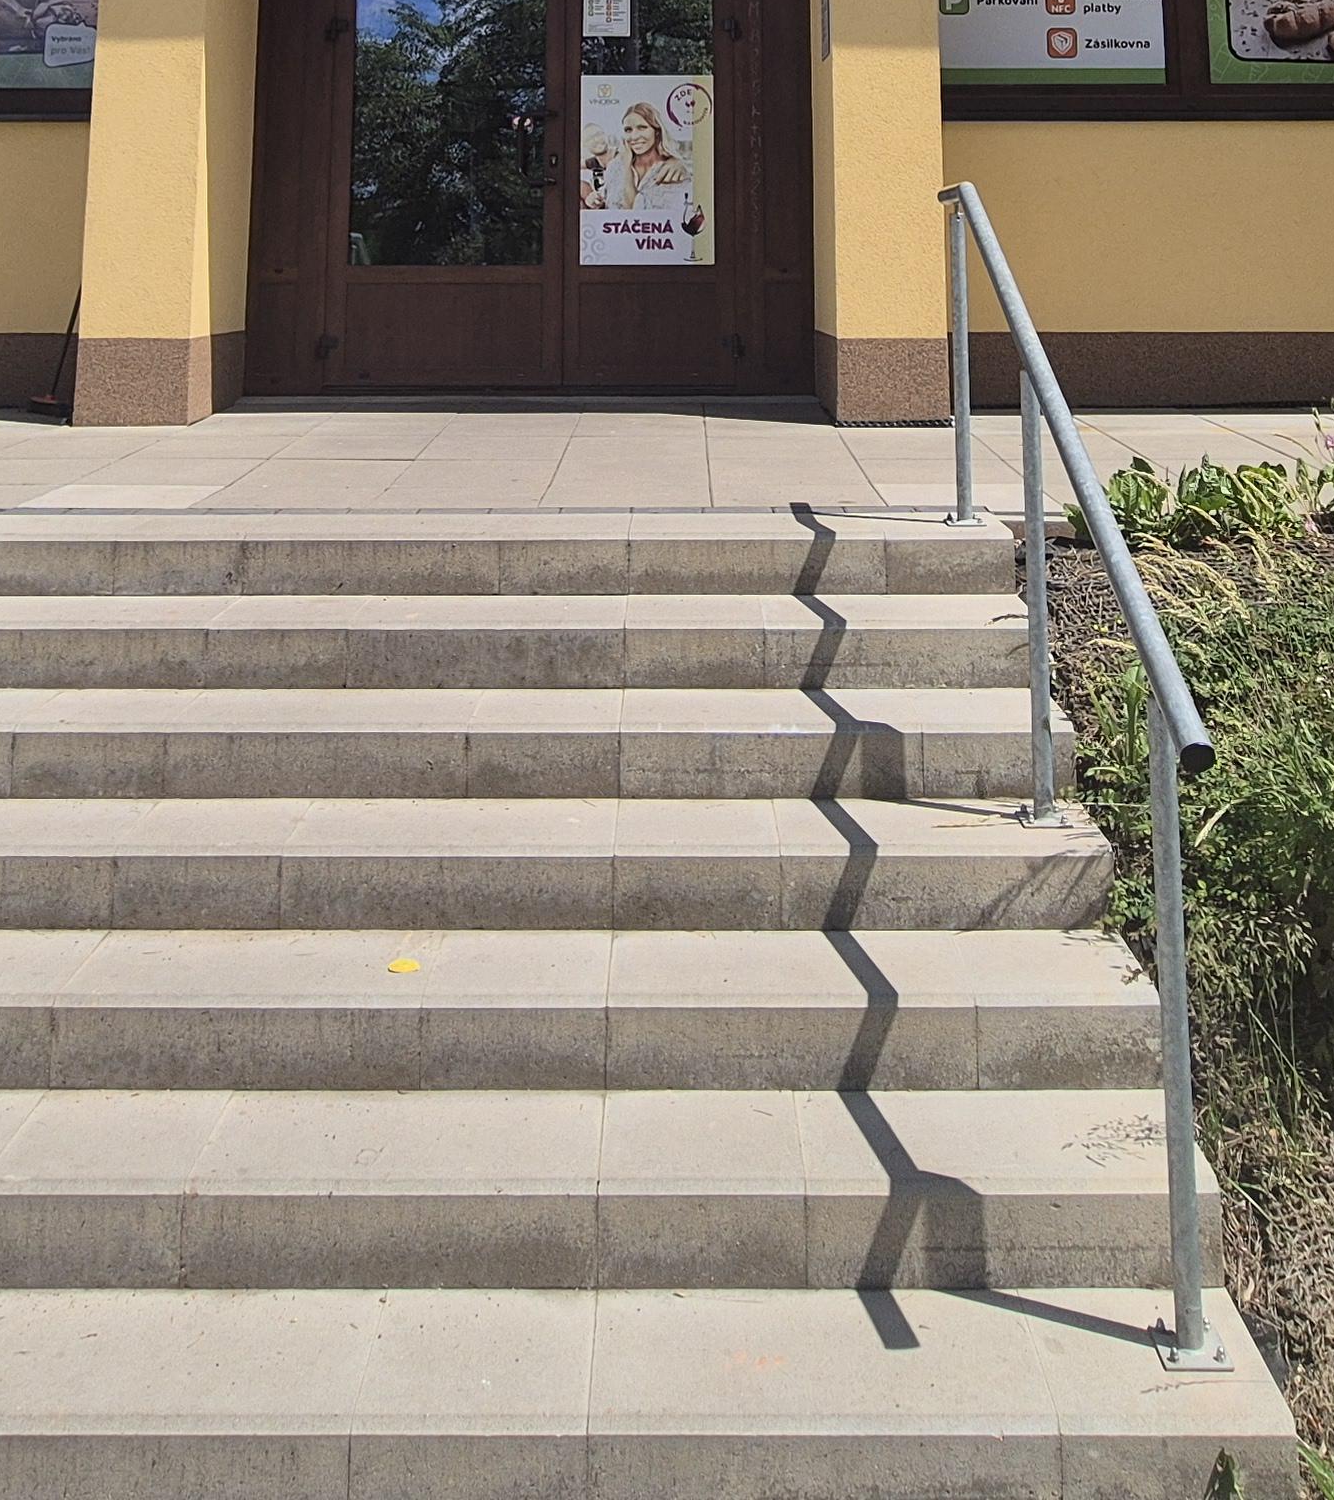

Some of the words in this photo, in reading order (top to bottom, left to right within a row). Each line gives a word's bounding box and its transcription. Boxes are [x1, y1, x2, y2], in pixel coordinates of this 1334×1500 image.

[1051, 5, 1070, 13] NFC
[1083, 3, 1121, 15] platby
[1085, 39, 1150, 50] Zásilkovna
[674, 89, 692, 101] ZDE
[603, 219, 674, 234] STÁČENÁ
[635, 236, 674, 250] VÍNA
